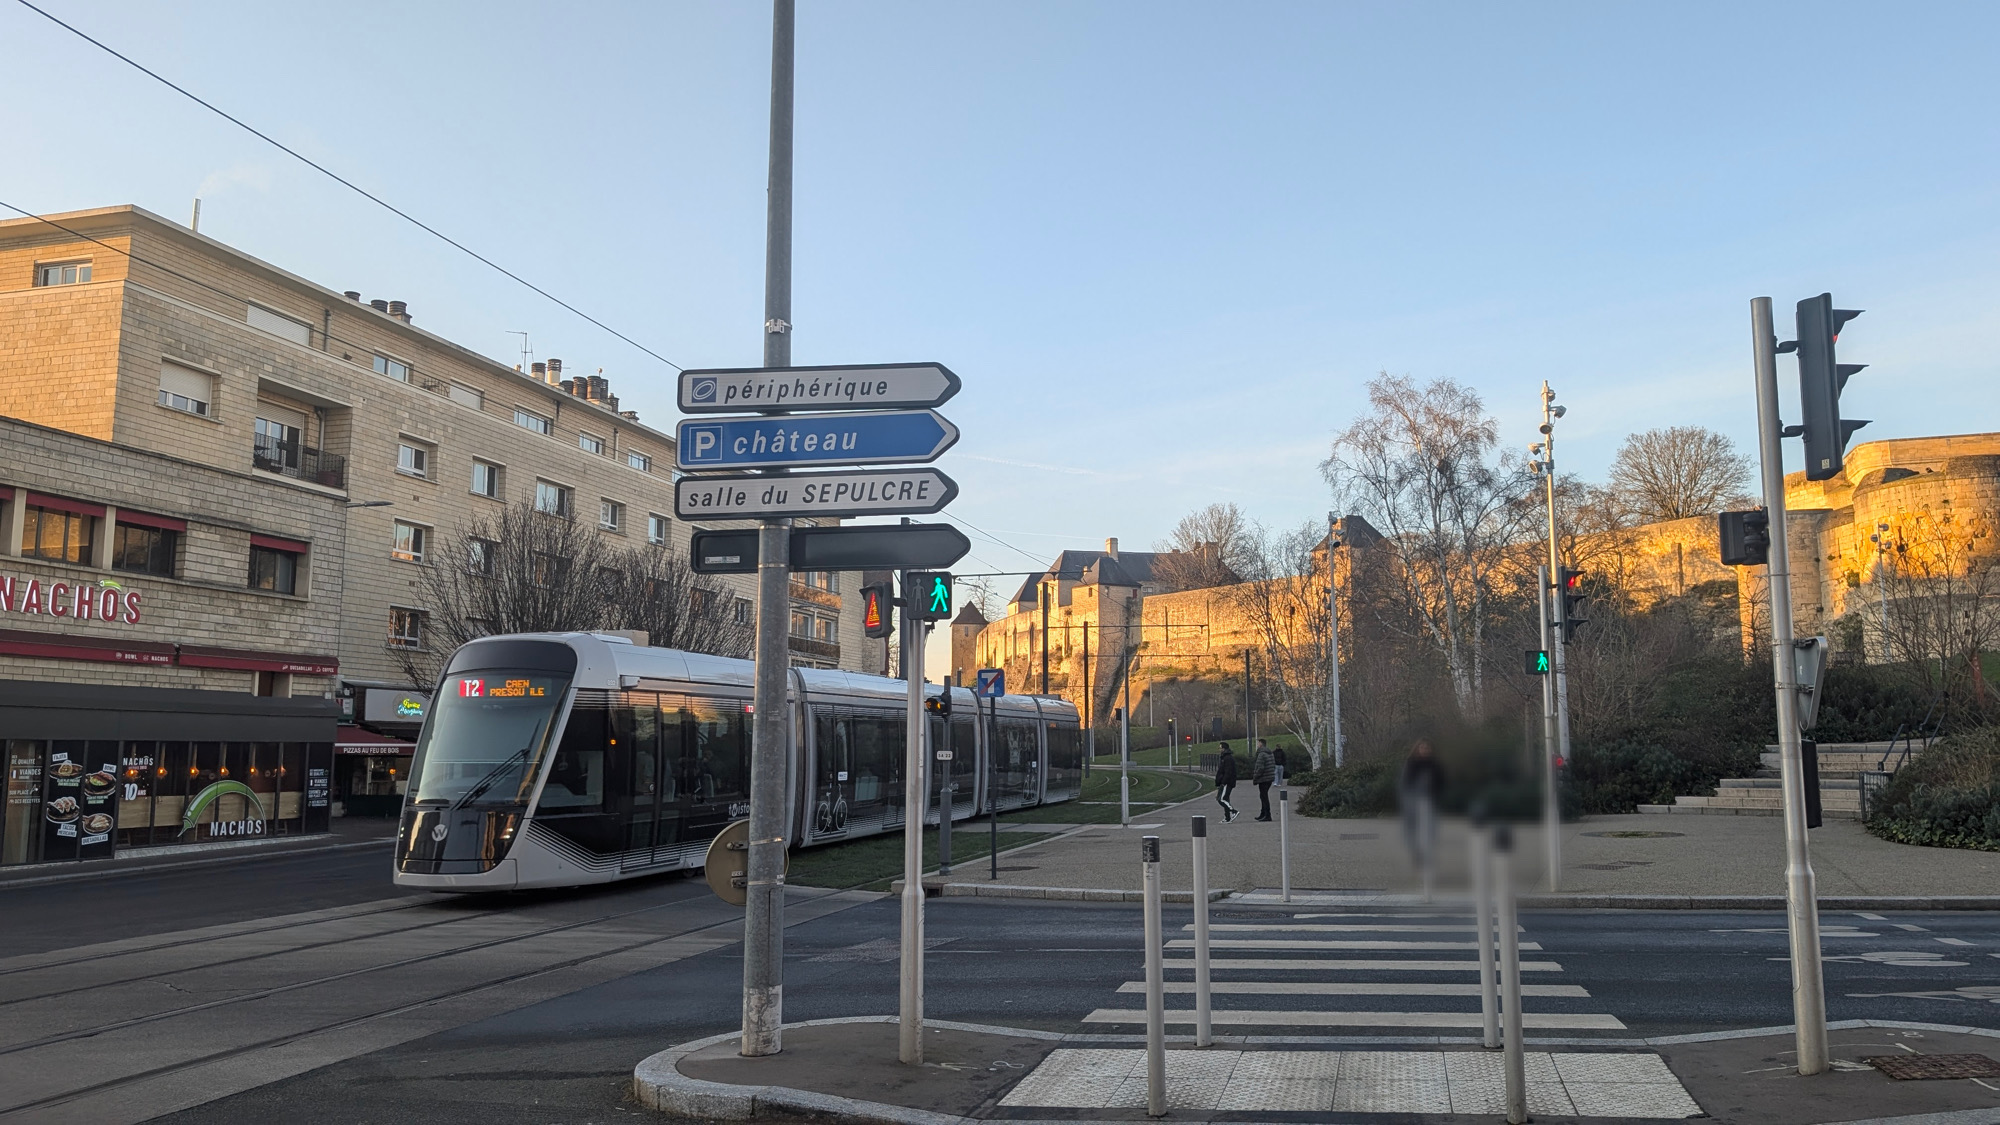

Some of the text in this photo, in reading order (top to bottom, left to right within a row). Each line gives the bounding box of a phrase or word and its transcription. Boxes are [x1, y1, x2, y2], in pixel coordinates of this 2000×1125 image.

[724, 378, 888, 404] périphérique
[695, 428, 858, 458] P château
[688, 479, 930, 508] salle du SEPULCRE
[464, 680, 480, 697] T2
[505, 679, 530, 688] CAEN
[210, 819, 262, 837] NACHOS
